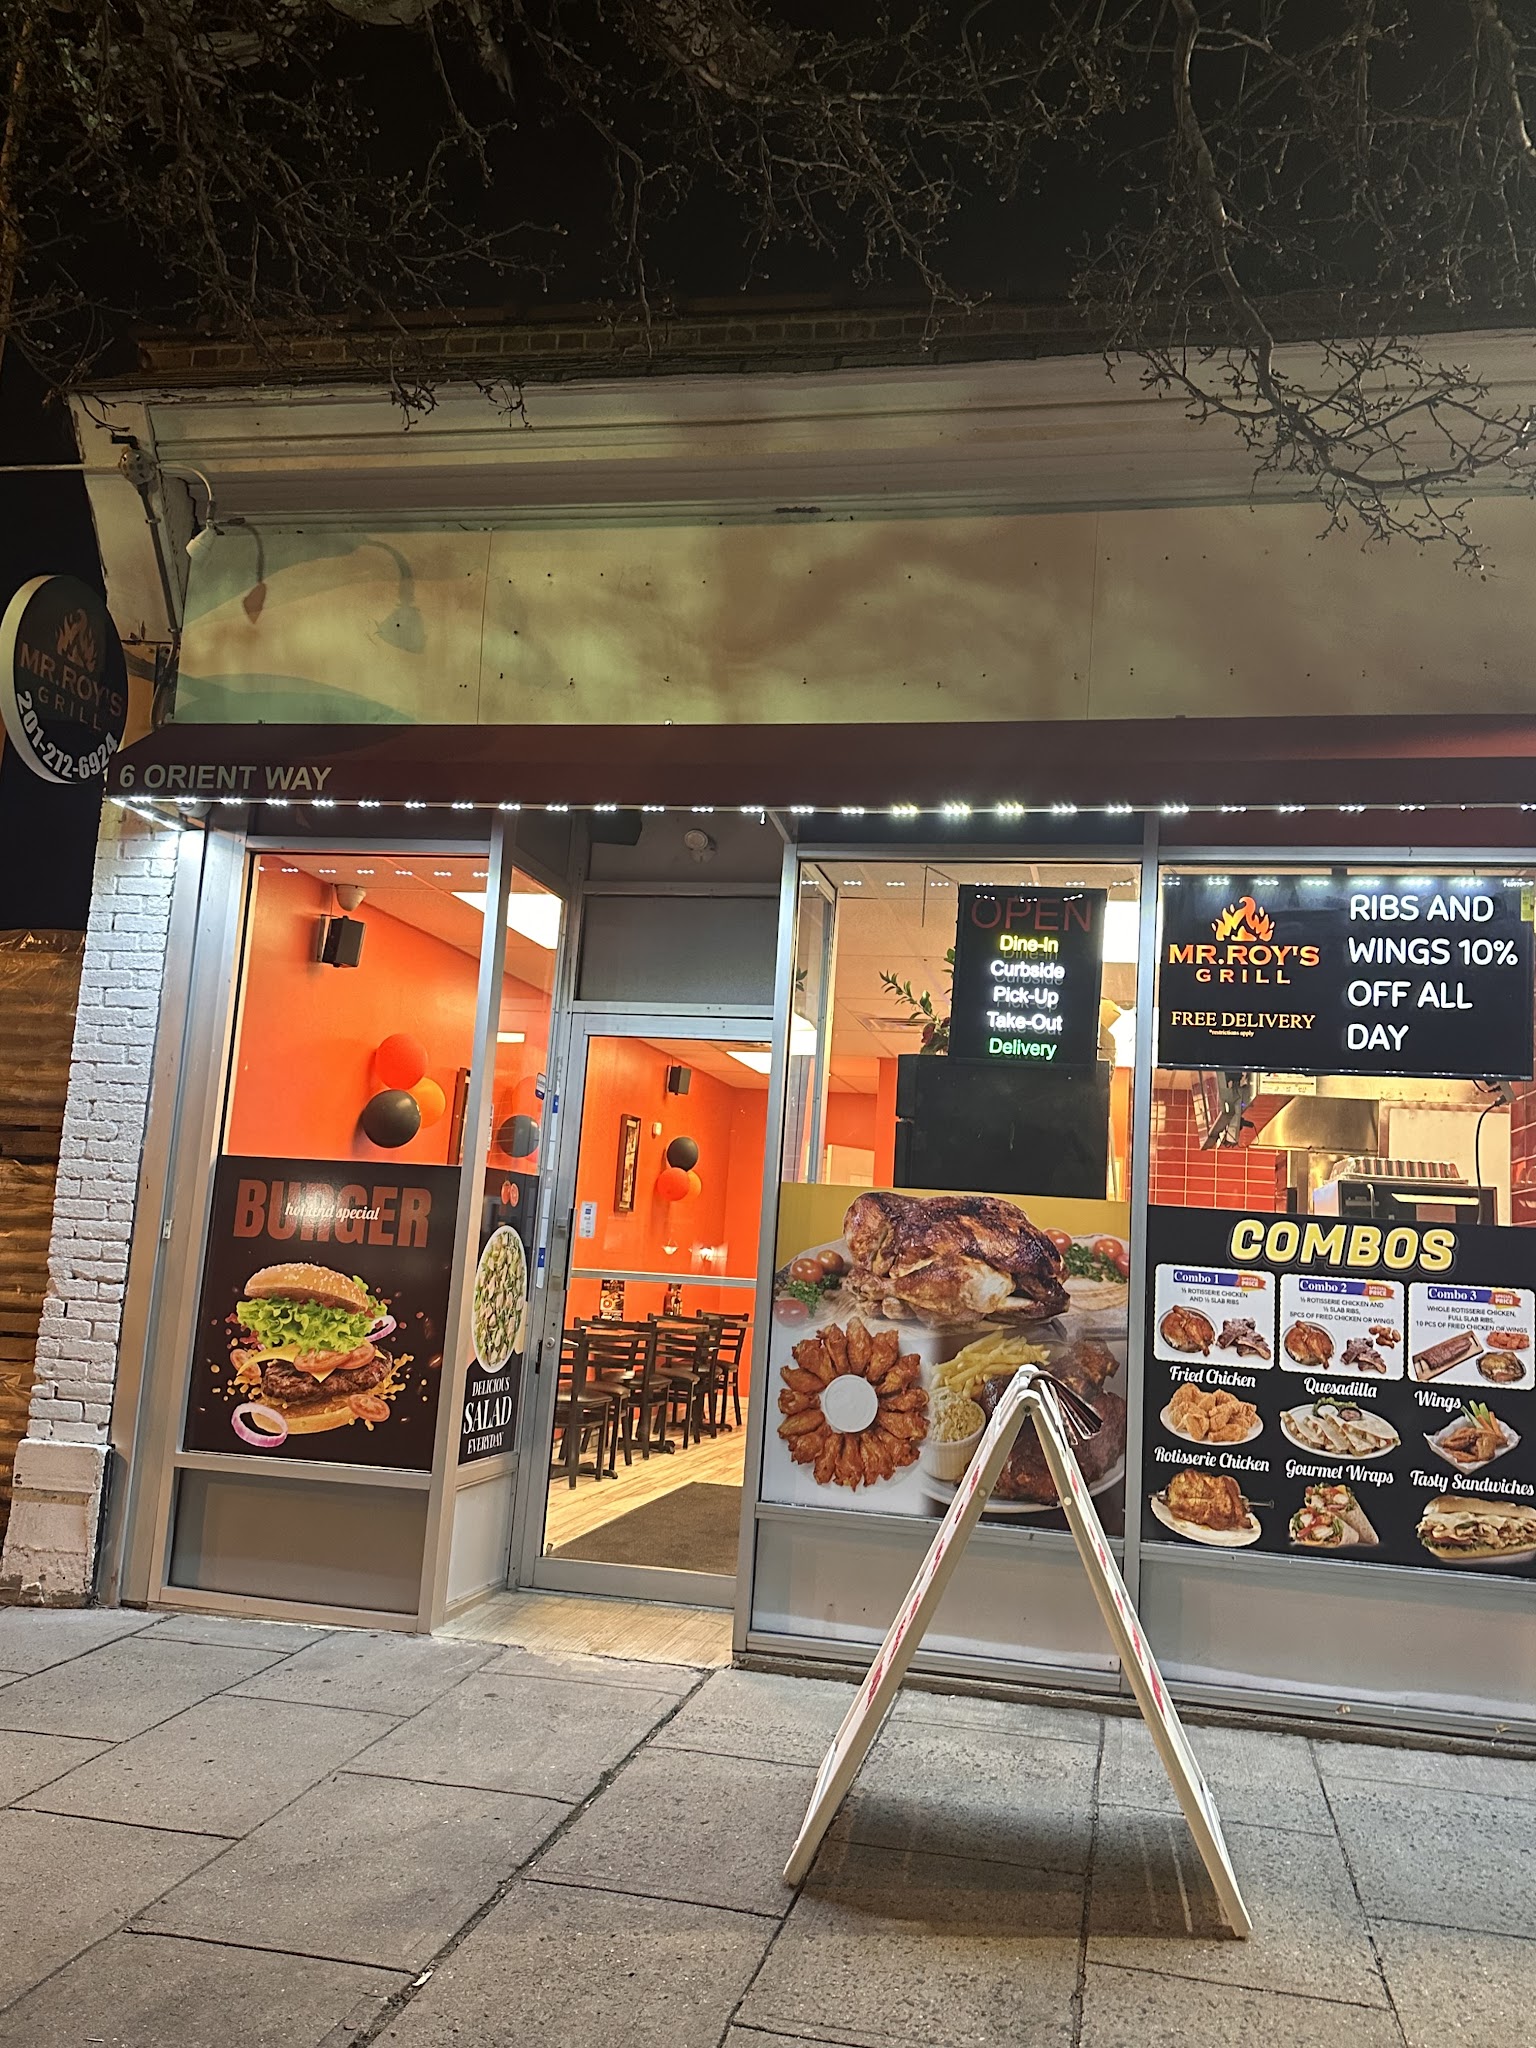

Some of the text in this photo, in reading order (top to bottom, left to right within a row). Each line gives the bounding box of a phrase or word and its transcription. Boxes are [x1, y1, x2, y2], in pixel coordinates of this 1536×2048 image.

[38, 686, 102, 731] GRILL
[17, 690, 118, 779] 201-272-6924
[119, 764, 332, 791] 6 ORIENT WAY
[971, 898, 1093, 932] OPEN
[1349, 894, 1419, 921] RIBS
[1426, 895, 1494, 922] AND
[1000, 934, 1059, 953] Dine-In
[1348, 937, 1519, 966] WINGS 10%
[990, 960, 1065, 979] Curbside
[1195, 968, 1291, 985] GRILL
[993, 985, 1059, 1006] Pick-Up
[1347, 980, 1473, 1010] OFF ALL
[986, 1010, 1063, 1031] Take-Out
[1171, 1011, 1316, 1029] FREE DELIVERY
[989, 1037, 1058, 1060] Delivery
[1347, 1024, 1409, 1051] DAY
[233, 1179, 431, 1248] BURGER
[335, 1206, 380, 1222] special
[1230, 1219, 1456, 1271] COMBOS
[1174, 1271, 1219, 1284] Combo 1
[1300, 1280, 1347, 1293] Combo 2
[1188, 1288, 1220, 1296] ROTISSERIE
[1221, 1290, 1248, 1298] CHICKEN
[1307, 1297, 1340, 1305] ROTISSERIE
[1428, 1288, 1477, 1300] Combo 3
[1451, 1307, 1485, 1315] ROTISSERIE
[472, 1377, 510, 1396] DELICIOUS
[1169, 1365, 1256, 1388] Fried Chicken
[1304, 1377, 1377, 1398] Quesadilla
[1414, 1390, 1461, 1413] Wings
[463, 1396, 512, 1434] SALAD
[467, 1432, 504, 1454] EVERYDAY
[1154, 1446, 1269, 1472] Rotisserie Chicken
[1285, 1459, 1394, 1487] Gourmet Wraps
[1410, 1470, 1534, 1496] Tasty Sandwiches
